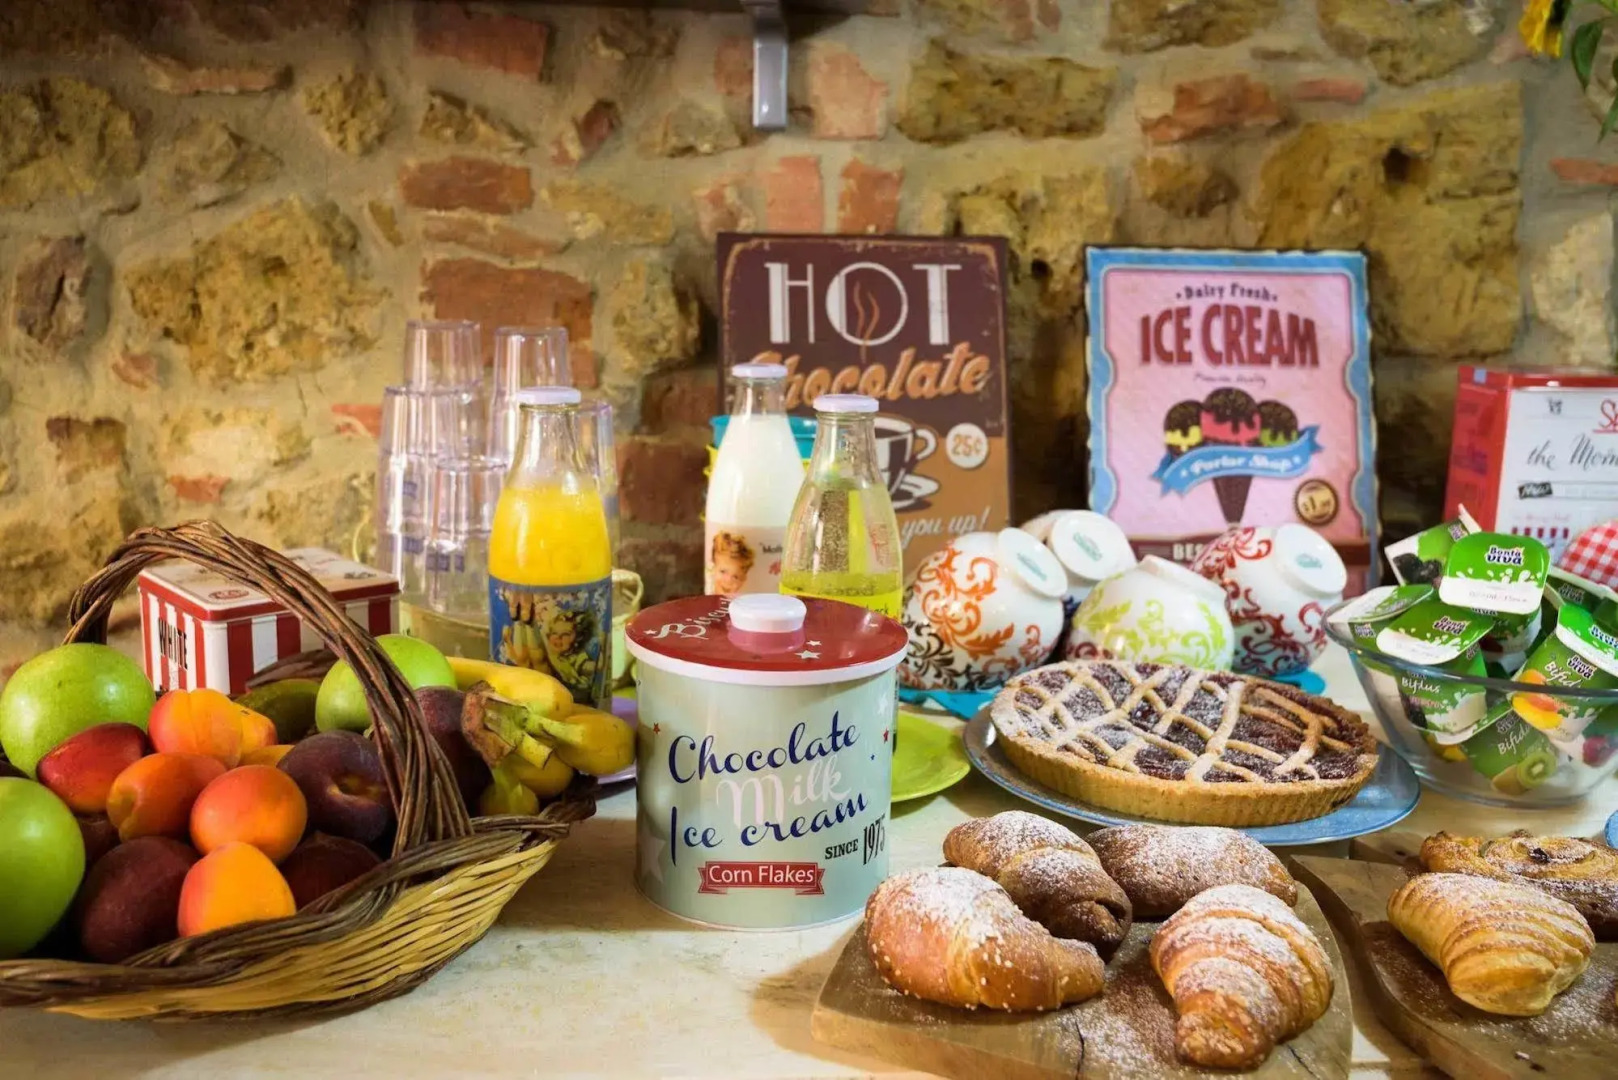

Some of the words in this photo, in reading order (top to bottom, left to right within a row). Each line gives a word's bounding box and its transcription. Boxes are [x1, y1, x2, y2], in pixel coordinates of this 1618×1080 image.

[764, 261, 962, 346] HOT
[1140, 305, 1192, 367] ICE
[1201, 303, 1320, 368] CREAM
[1527, 439, 1556, 472] the
[900, 517, 942, 550] you
[158, 616, 188, 670] WHITE
[668, 710, 860, 784] Chocolate
[716, 755, 852, 830] Milk
[671, 806, 723, 867] Ice
[741, 792, 869, 846] cream
[824, 838, 859, 860] SINCE
[863, 812, 886, 866] 1975
[709, 865, 752, 883] Corn
[758, 864, 814, 883] Flakes
